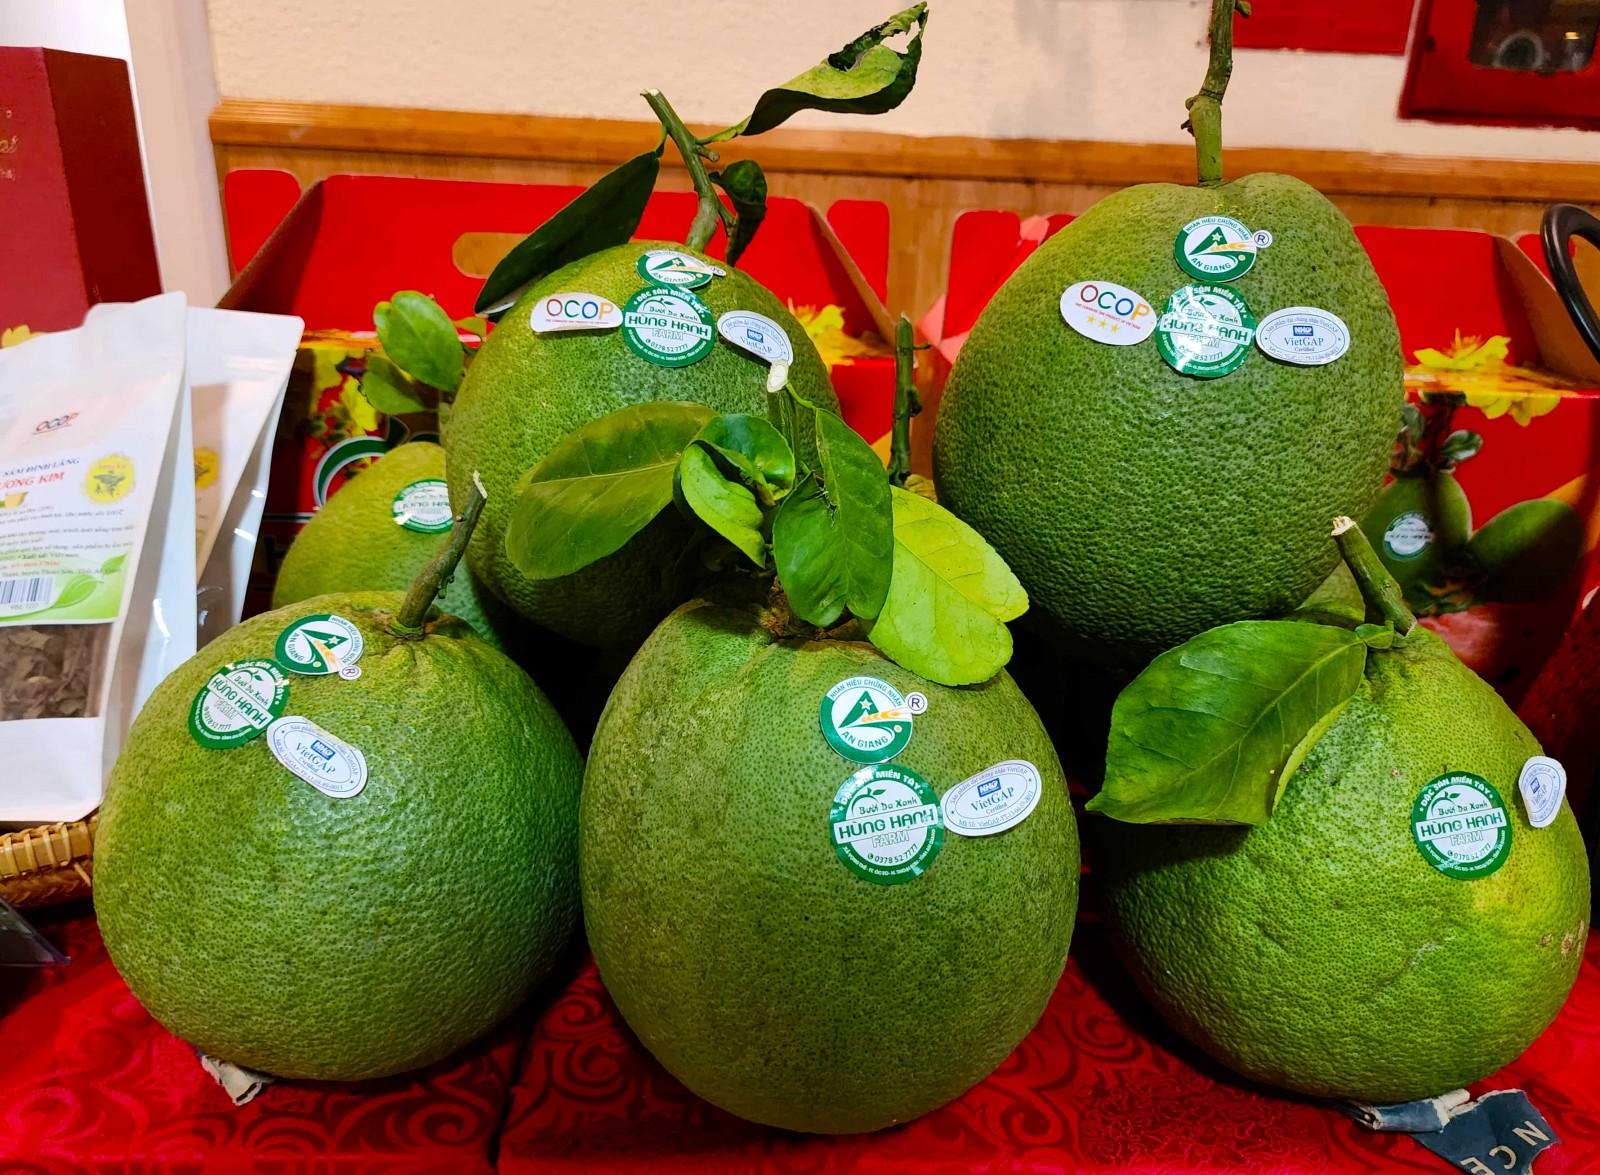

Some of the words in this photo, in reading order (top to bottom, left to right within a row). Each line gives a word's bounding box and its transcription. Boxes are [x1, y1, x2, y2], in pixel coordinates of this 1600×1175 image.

[1190, 257, 1203, 267] AN
[1203, 262, 1232, 272] GIANG
[546, 298, 614, 321] OCOP
[1080, 284, 1151, 321] OCOP
[628, 314, 668, 328] HÙNG
[671, 320, 709, 337] HẠNH
[1284, 336, 1324, 346] VietGAP
[39, 471, 65, 484] KIM
[211, 677, 238, 701] HÙNG
[234, 696, 268, 726] HẠNH
[841, 730, 857, 745] AN
[857, 735, 889, 749] GIANG
[296, 742, 336, 774] VietGAP
[880, 802, 894, 811] Da
[895, 796, 918, 808] Xanh
[970, 786, 1015, 811] VietGAP
[1470, 800, 1489, 810] Xanh
[838, 819, 886, 839] HÙNG
[889, 808, 935, 830] HẠNH
[1420, 819, 1463, 838] HÙNG
[1465, 811, 1503, 830] HẠNH
[871, 830, 910, 849] FARM
[1449, 830, 1484, 847] FARM
